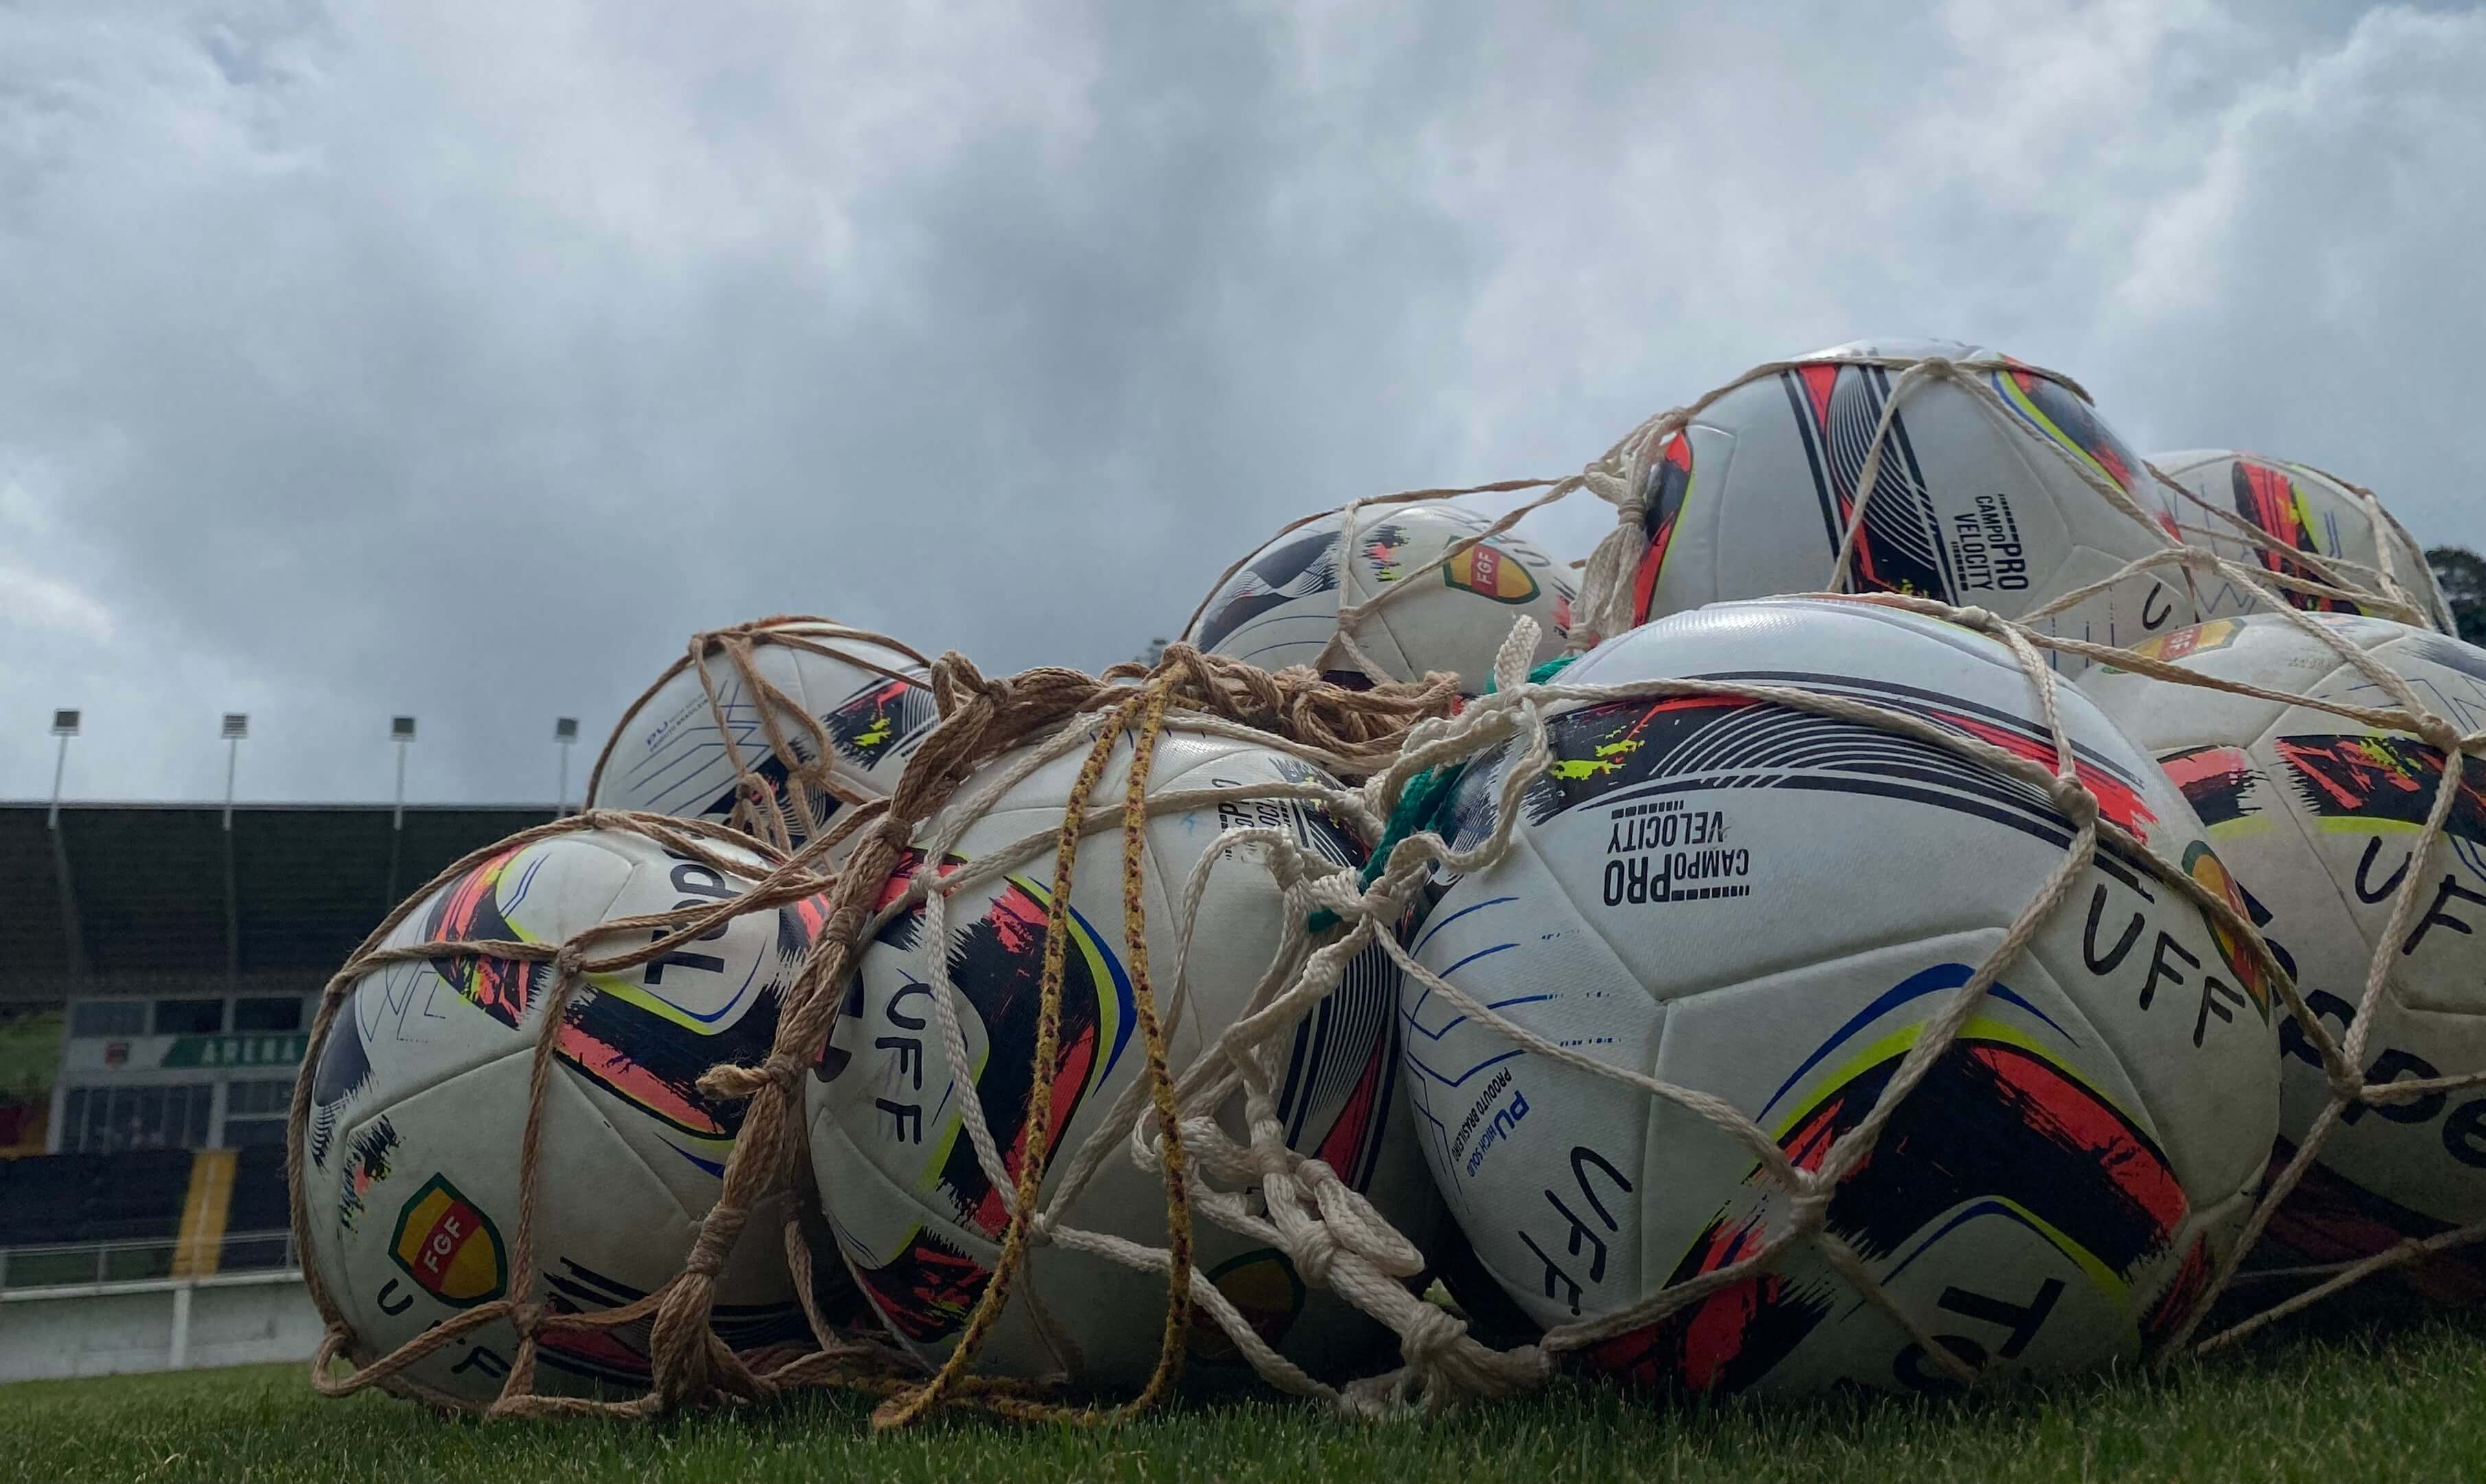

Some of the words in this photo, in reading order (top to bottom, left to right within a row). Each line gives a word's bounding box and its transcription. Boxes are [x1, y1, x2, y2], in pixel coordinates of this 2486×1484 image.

[1476, 551, 1495, 585] FGF
[1954, 513, 1994, 590] VELOCITY
[1975, 496, 2005, 542] CAMPO
[1990, 543, 2029, 590] PRO
[1607, 811, 1724, 855] VELOCITY
[1603, 853, 1672, 907] PRO
[1673, 848, 1749, 881] CAMPO
[2083, 883, 2246, 1048] UFF
[875, 982, 927, 1145] UFF
[1475, 1066, 1512, 1115] PRODUTO
[1451, 1107, 1481, 1163] BRASILEIRO
[1493, 1089, 1530, 1141] PU
[422, 1215, 462, 1275] FGF
[1517, 1146, 1633, 1317] UFF
